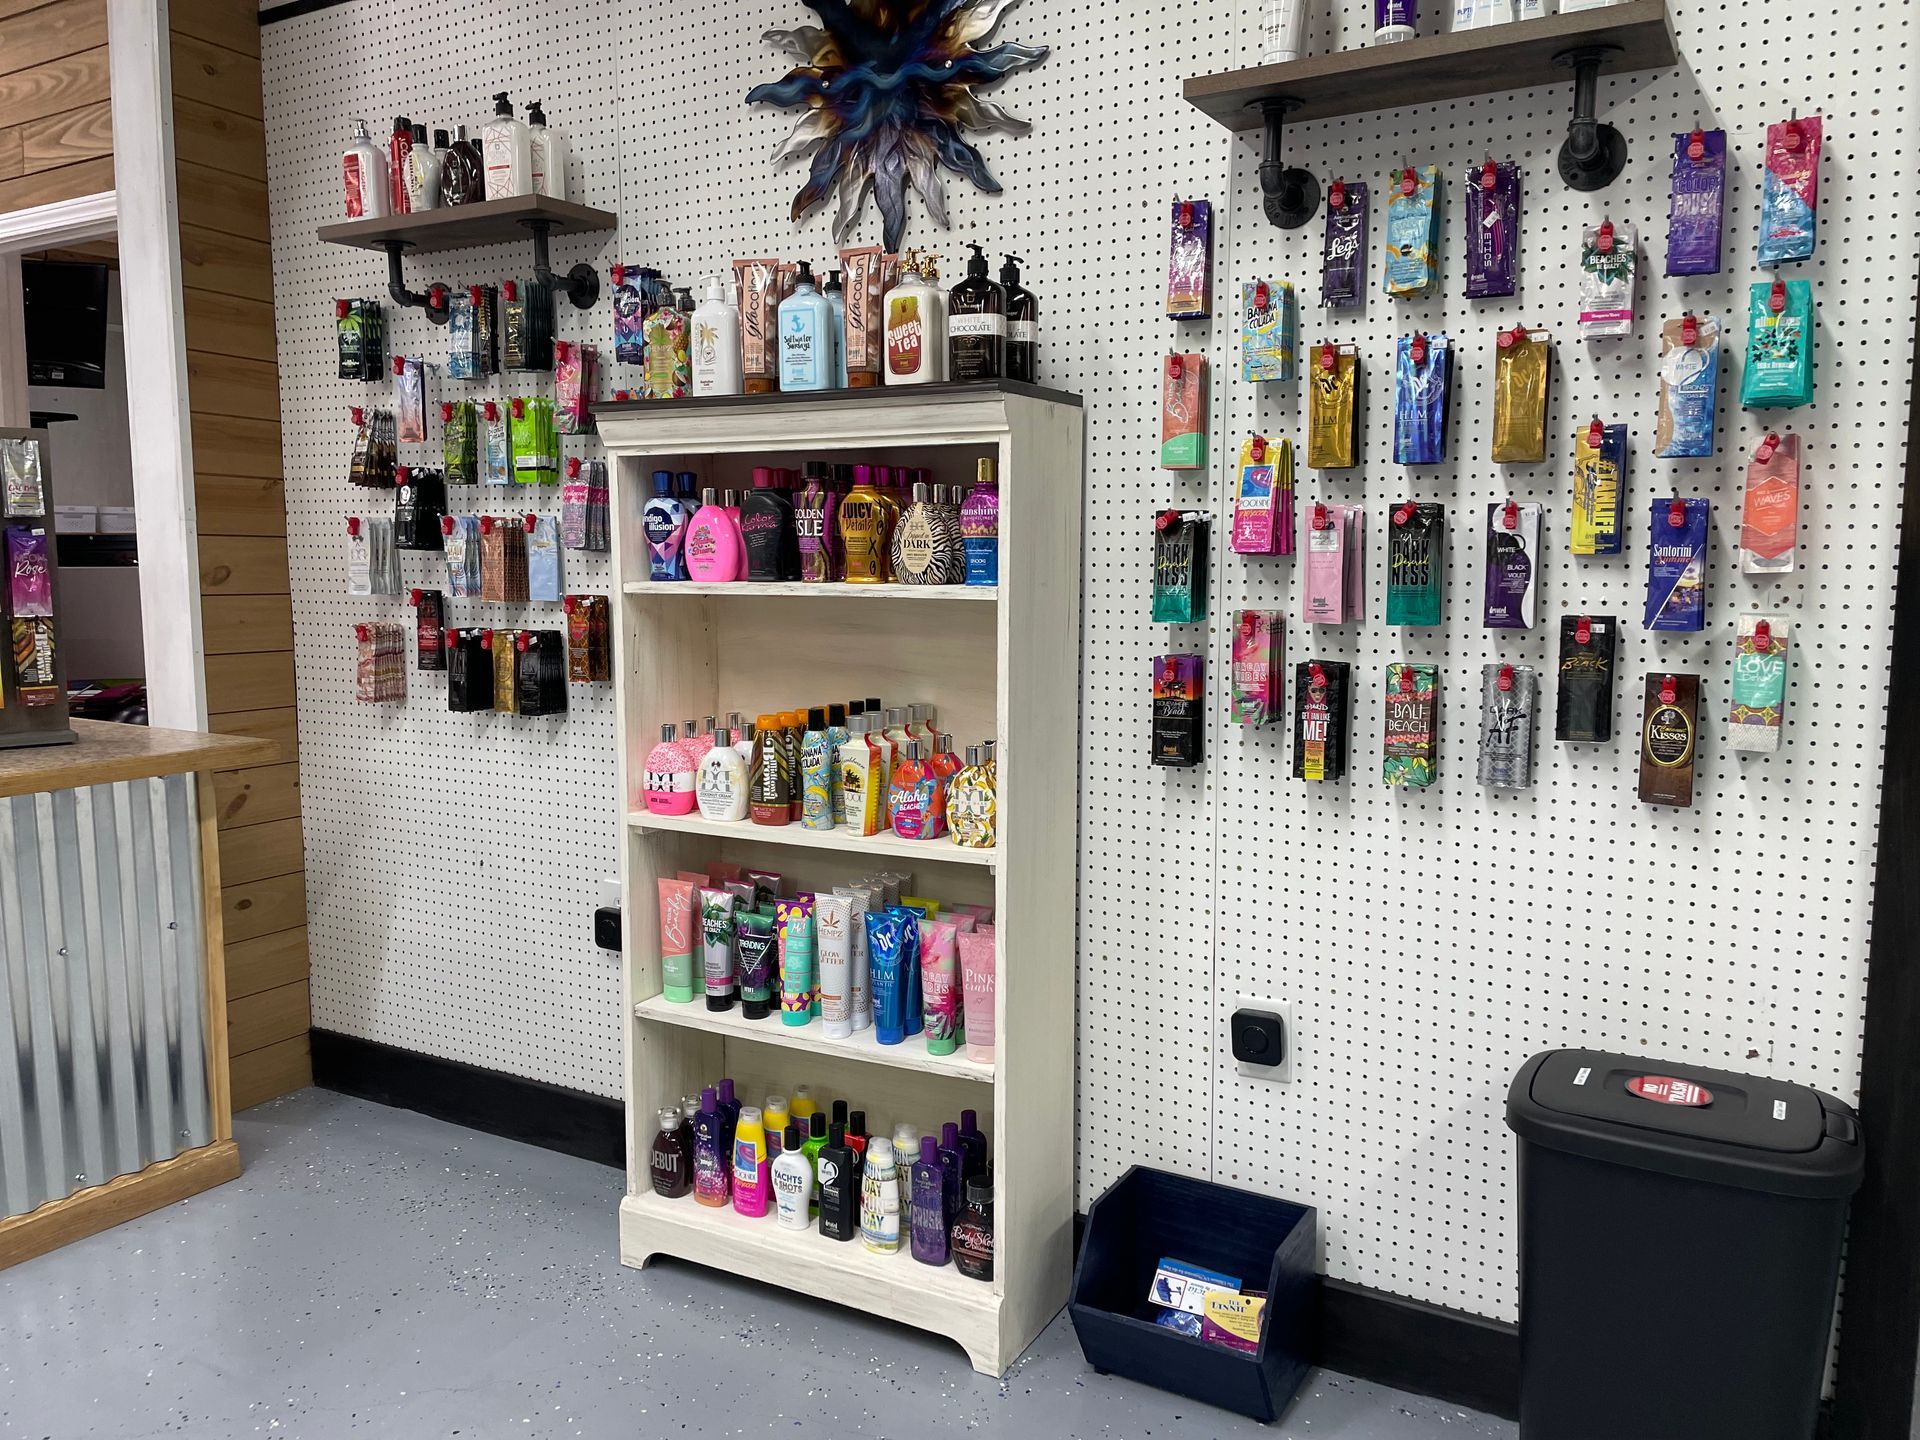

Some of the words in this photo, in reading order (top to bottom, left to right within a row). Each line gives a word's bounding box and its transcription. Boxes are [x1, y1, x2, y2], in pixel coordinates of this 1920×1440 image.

[1327, 234, 1359, 261] Legs
[1590, 254, 1627, 265] BEACHES
[950, 324, 992, 333] CHOCOLATE
[1249, 313, 1276, 330] COLADA
[887, 319, 922, 346] Sweet
[896, 338, 918, 354] Tea
[1754, 490, 1791, 507] WAVES
[842, 502, 873, 519] JUICY
[648, 520, 675, 531] illusion
[903, 540, 931, 549] DARK
[1653, 543, 1693, 558] Santorini
[14, 560, 47, 578] Rose
[1736, 658, 1784, 673] LOVE
[1393, 703, 1424, 720] BALI
[1303, 720, 1328, 742] ME!
[1388, 719, 1428, 733] BEACH
[1651, 724, 1687, 741] Kisses
[891, 789, 928, 804] Aloha
[1669, 1080, 1690, 1103] TRASH
[774, 1169, 803, 1185] YACHTS
[779, 1181, 803, 1193] SHOTS
[865, 1178, 882, 1198] DAY
[864, 1211, 884, 1231] DAY
